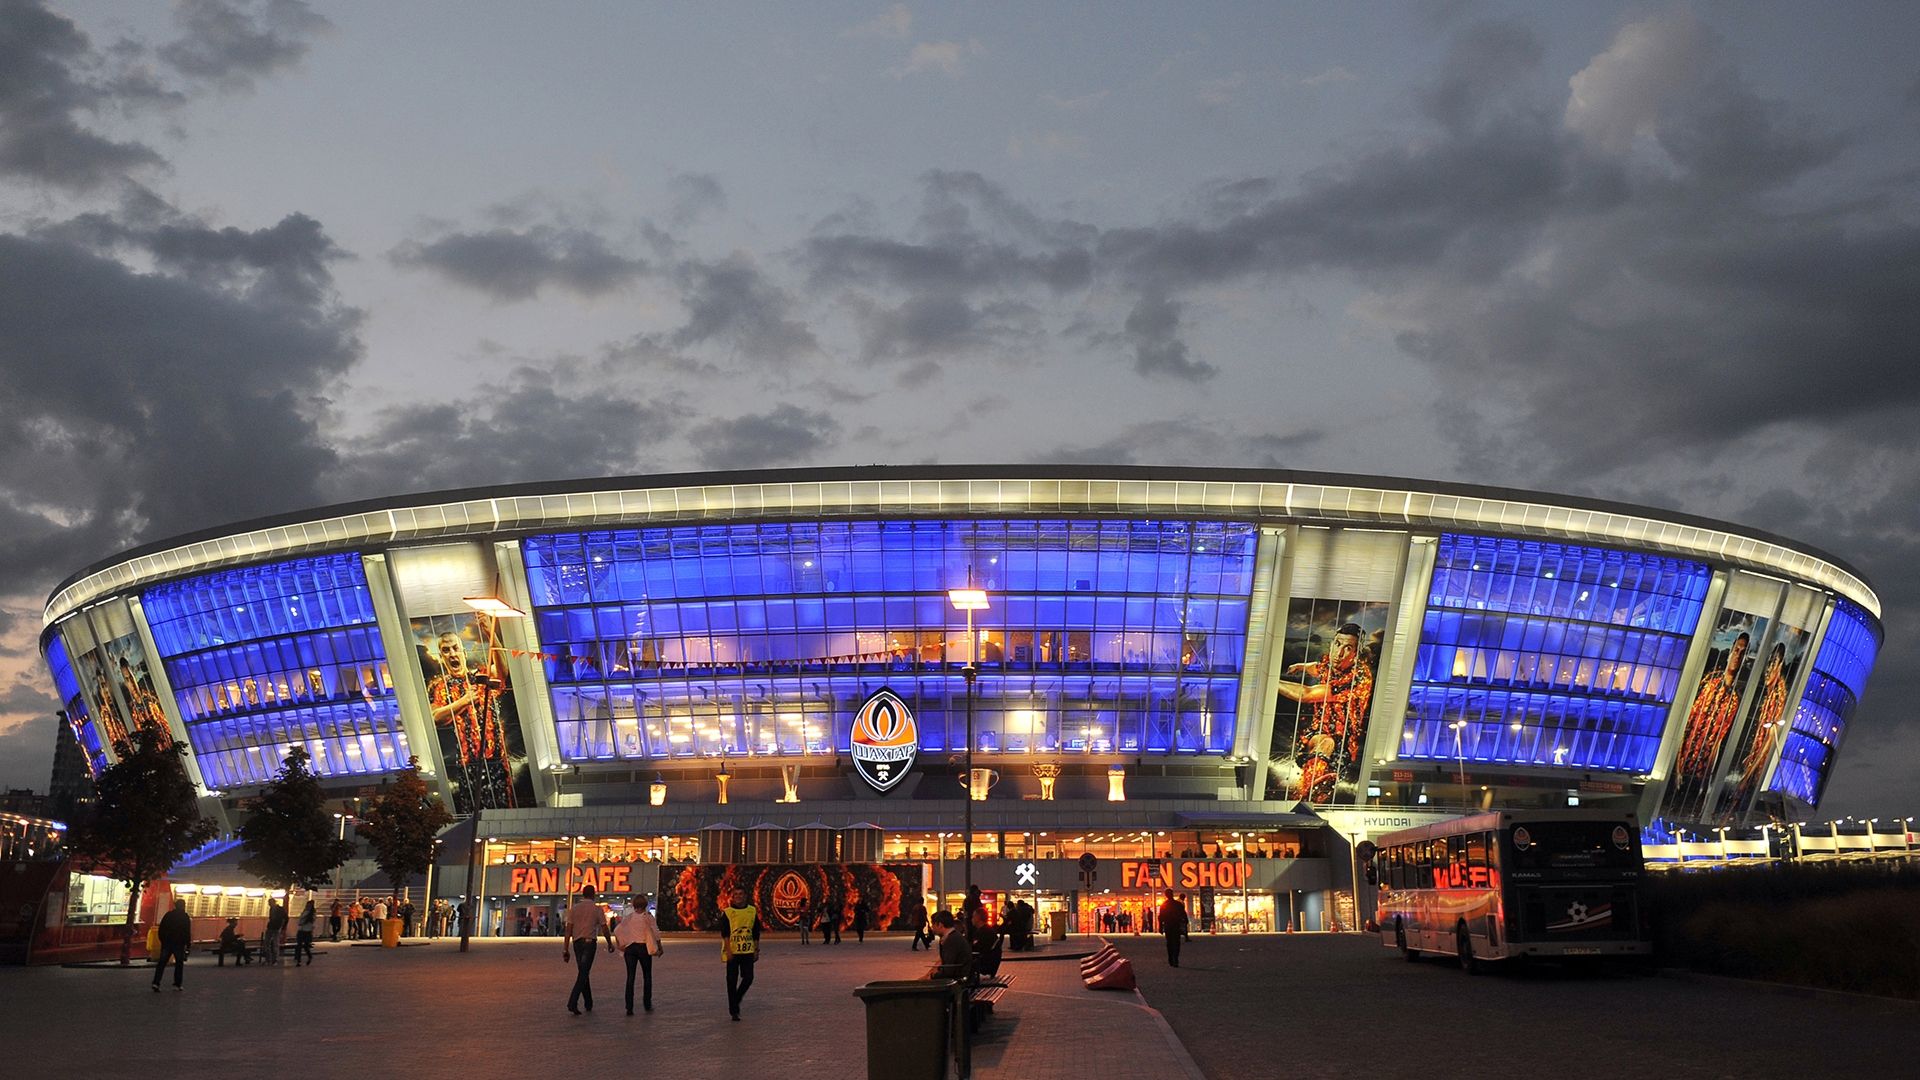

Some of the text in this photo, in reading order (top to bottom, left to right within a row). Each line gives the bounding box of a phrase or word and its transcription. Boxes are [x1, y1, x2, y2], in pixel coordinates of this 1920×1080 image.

[853, 743, 916, 761] ШАХТАР
[1363, 817, 1411, 827] HYUNDAI
[510, 866, 632, 893] FAN CAFE
[1121, 861, 1174, 888] FAN
[1180, 861, 1253, 888] SHOP
[736, 942, 752, 952] 187
